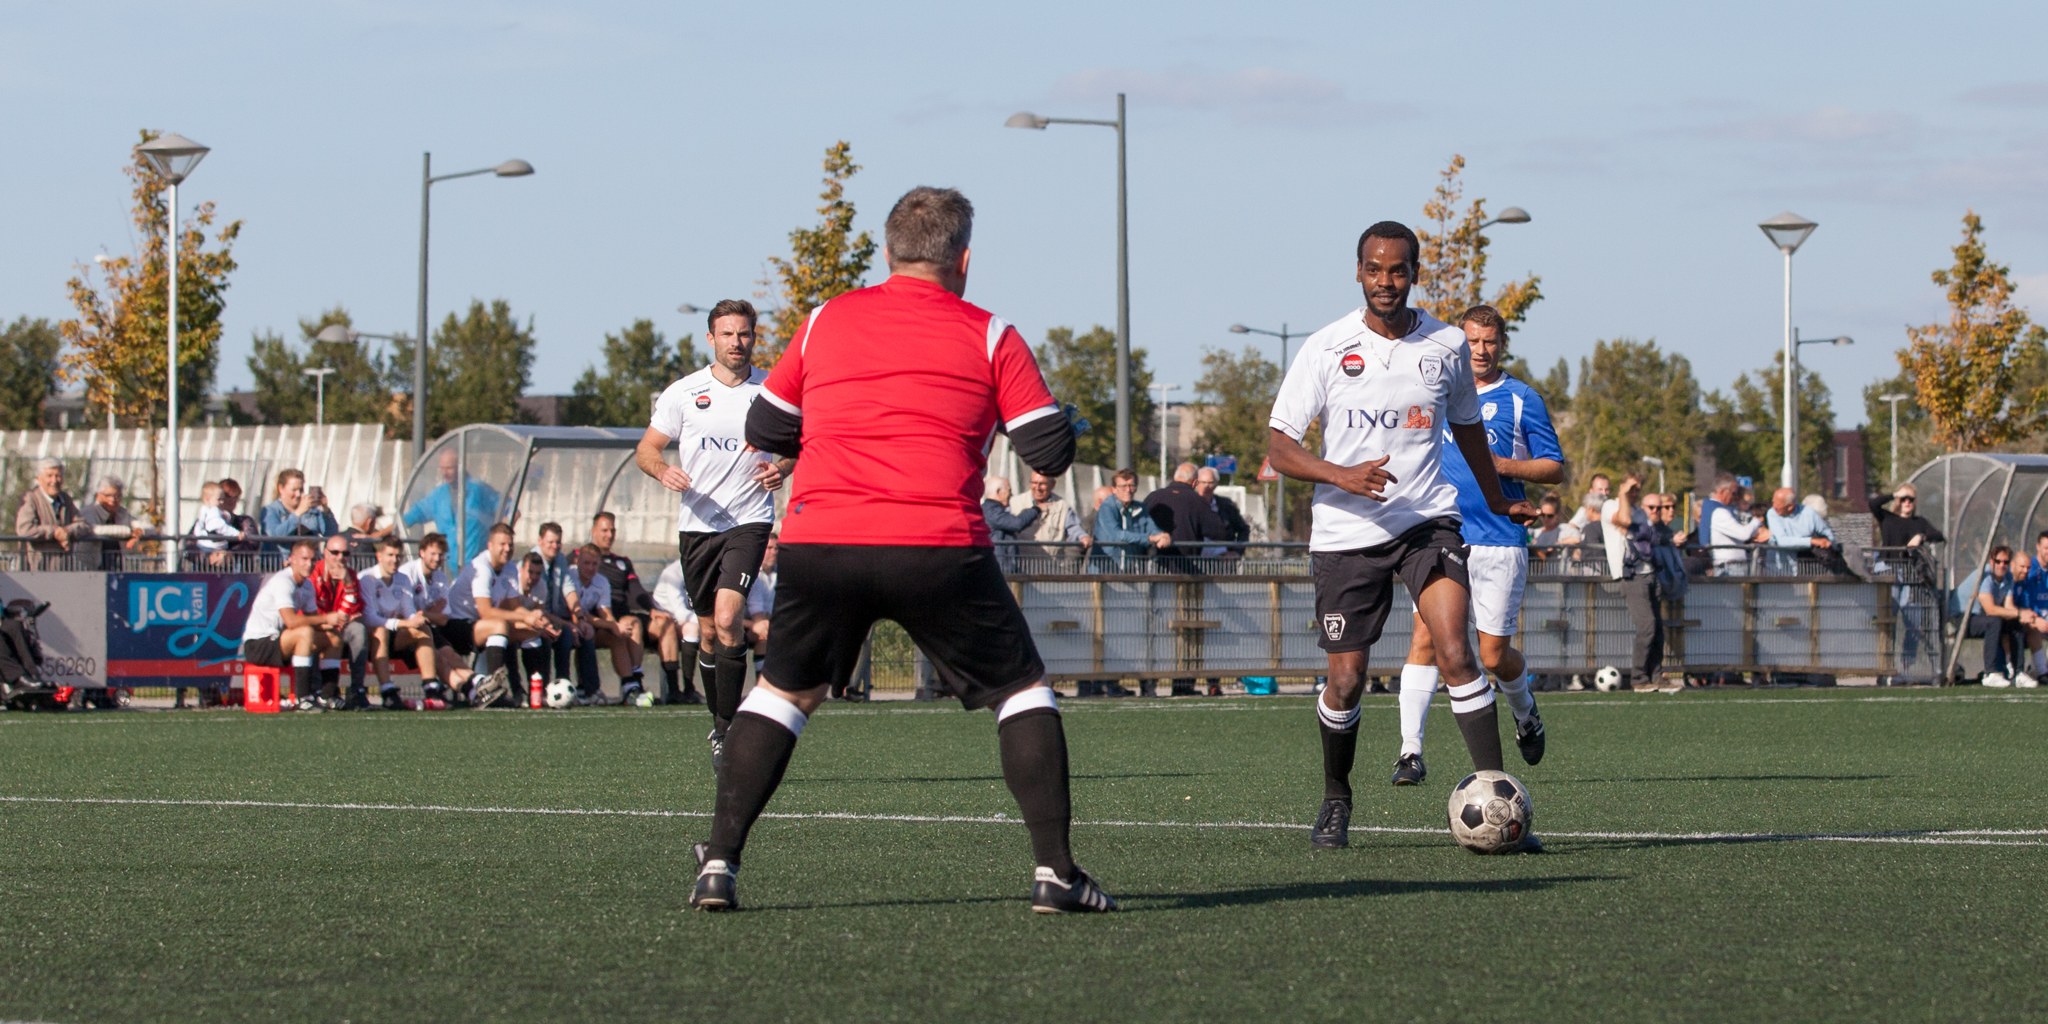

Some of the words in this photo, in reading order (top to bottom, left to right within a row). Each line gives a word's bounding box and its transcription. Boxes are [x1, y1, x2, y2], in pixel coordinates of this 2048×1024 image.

[1346, 409, 1399, 429] ING
[701, 437, 738, 452] ING
[740, 572, 751, 588] 11
[133, 586, 190, 631] J.C.
[193, 588, 204, 620] van
[43, 656, 96, 676] 56260
